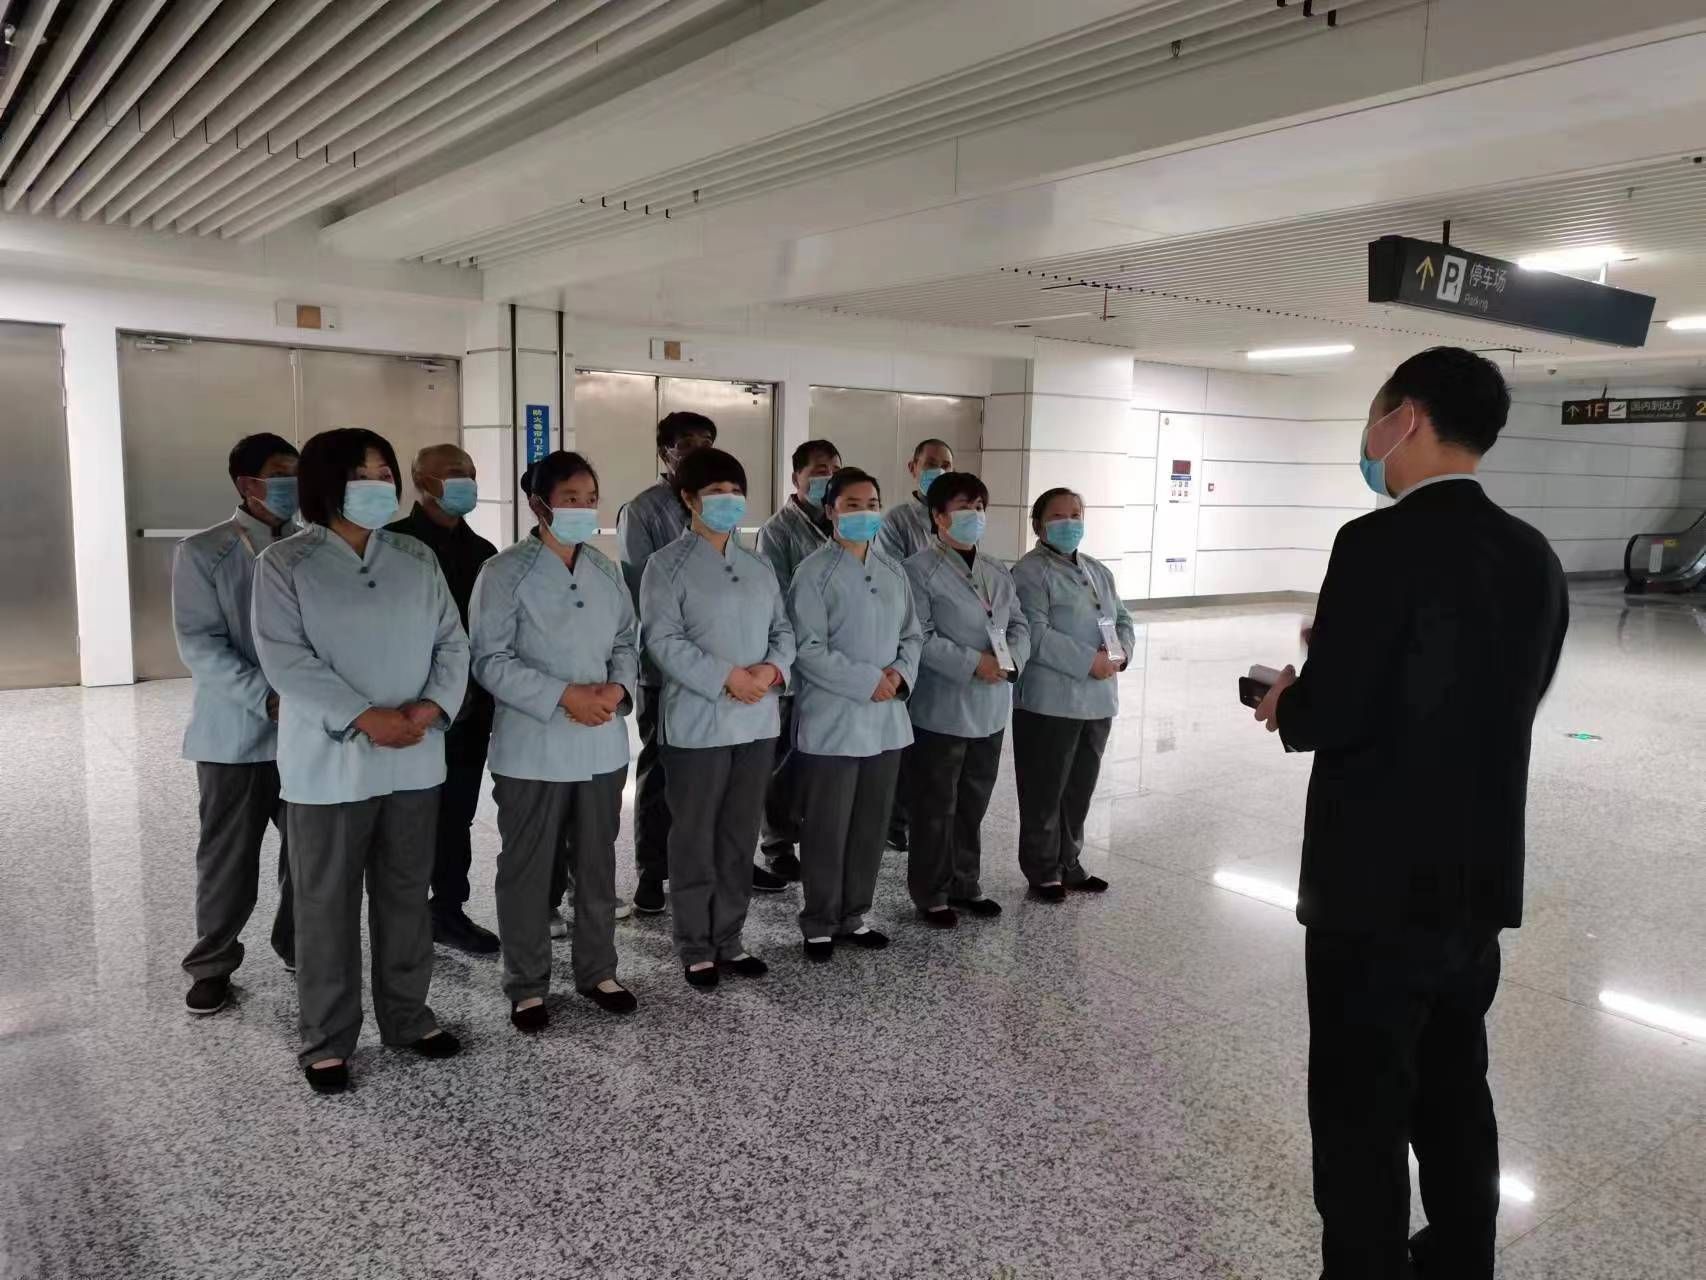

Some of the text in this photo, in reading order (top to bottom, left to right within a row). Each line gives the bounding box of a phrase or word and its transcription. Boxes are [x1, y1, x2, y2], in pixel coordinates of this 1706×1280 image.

[1469, 263, 1507, 293] 停车场
[1464, 293, 1489, 312] Parking
[1584, 403, 1604, 417] 1F
